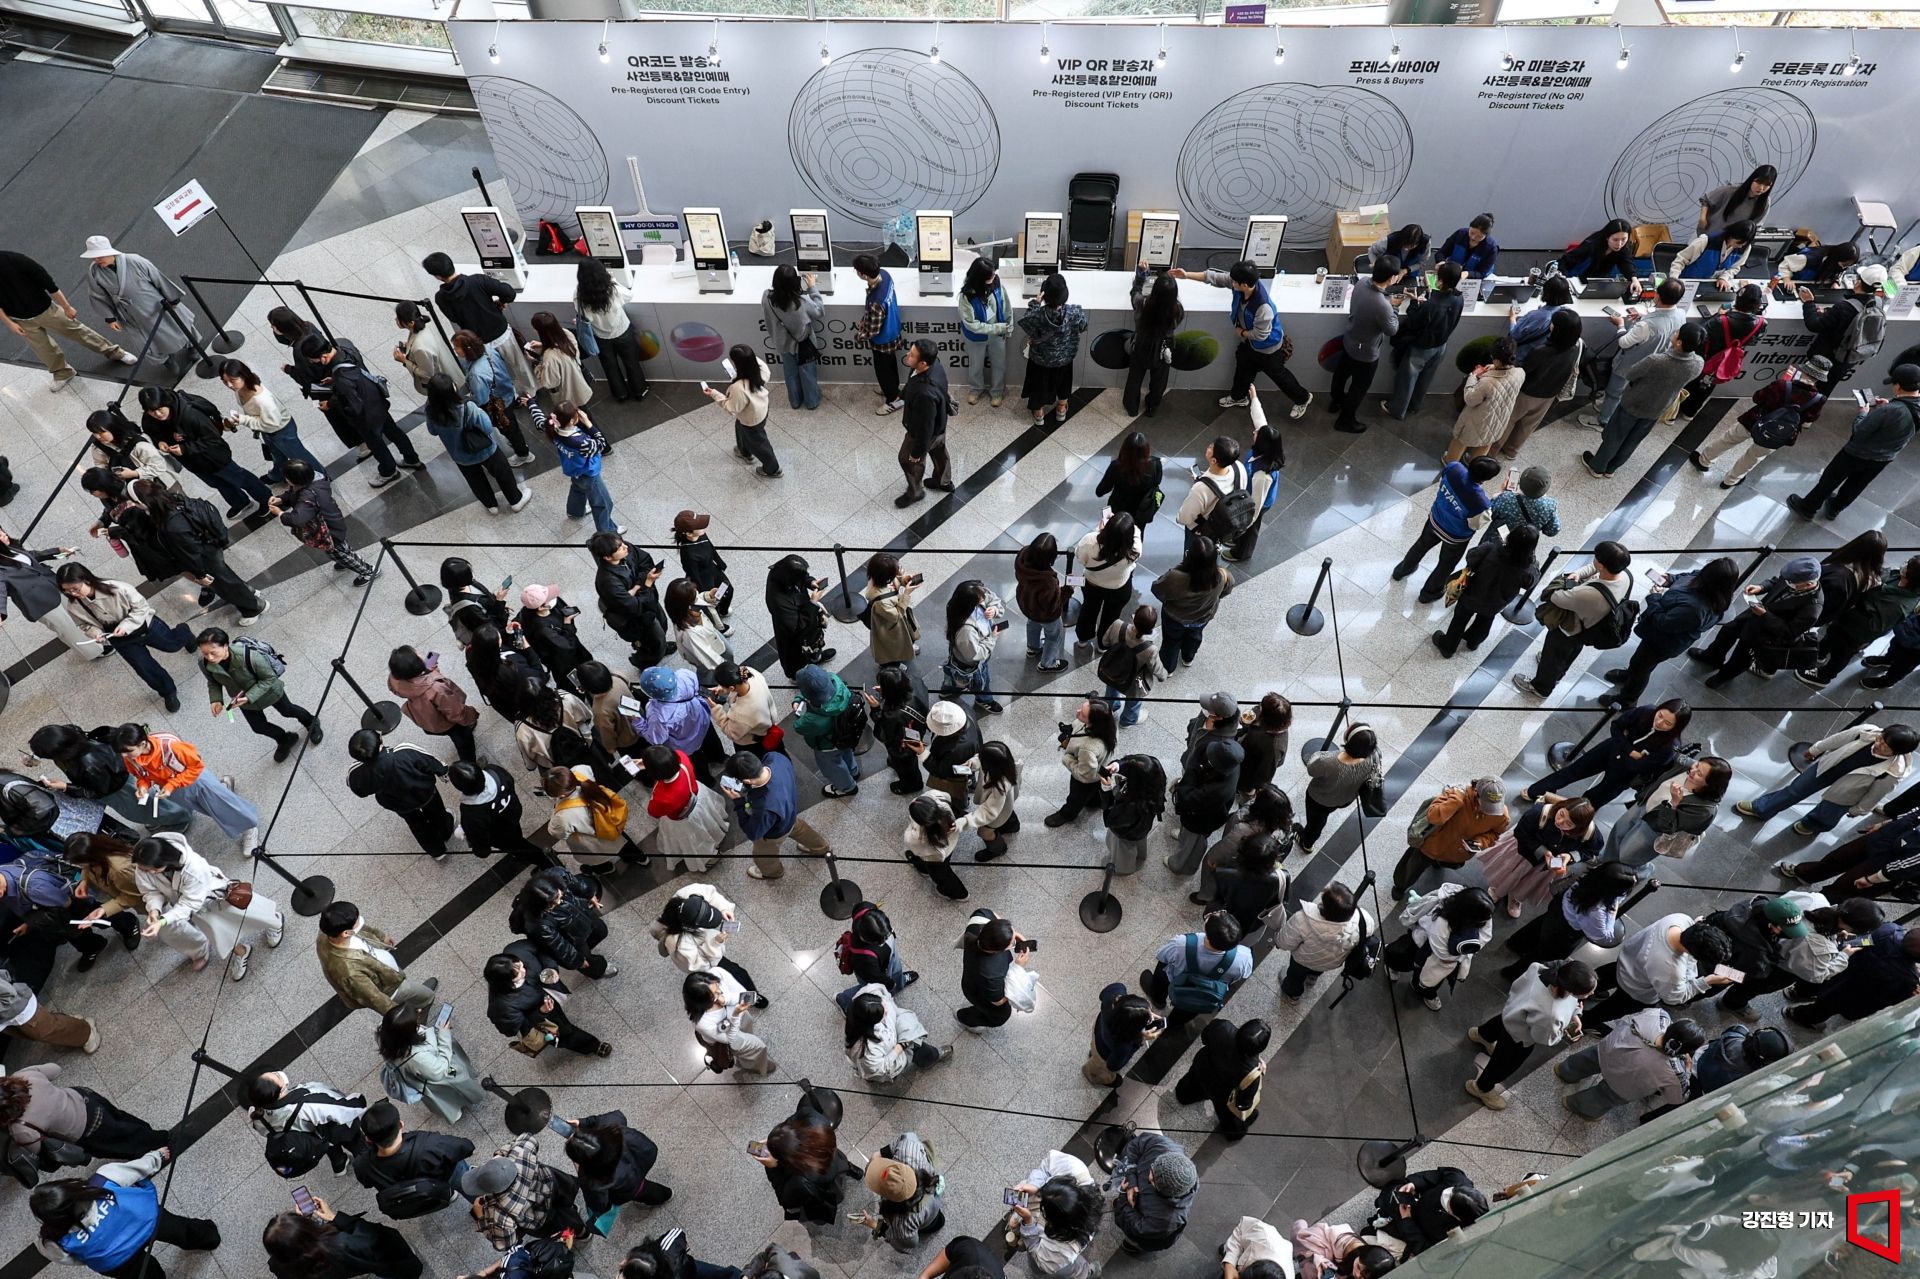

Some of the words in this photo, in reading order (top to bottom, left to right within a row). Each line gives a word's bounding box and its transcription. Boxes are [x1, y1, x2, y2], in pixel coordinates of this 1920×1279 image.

[627, 55, 677, 68] QR코드
[1057, 59, 1082, 71] VIP
[1086, 59, 1108, 72] QR
[1112, 59, 1154, 72] 발송자
[1349, 60, 1441, 73] 프레스/바이어
[1527, 60, 1586, 73] 미발송자
[1769, 62, 1829, 75] 무료등록
[1829, 63, 1878, 76] 대자
[626, 71, 730, 82] 사전등록&할인예매
[1051, 74, 1158, 86] 사전등록&할인예매
[1355, 77, 1382, 85] Press
[1383, 77, 1391, 85] &
[1392, 77, 1424, 86] Buyers
[1482, 75, 1592, 88] 사전등록&할인예매
[1783, 79, 1809, 87] Entry
[1810, 79, 1868, 88] Registration
[611, 86, 677, 95] Pre-Registered
[679, 86, 696, 95] (QR
[698, 86, 721, 95] Code
[723, 87, 750, 95] Entry)
[1032, 89, 1100, 99] Pre-Registered
[1102, 90, 1121, 99] (VIP
[1123, 91, 1146, 100] Entry
[1149, 91, 1173, 100] (QR))
[1478, 91, 1547, 100] Pre-Registered
[1548, 92, 1565, 100] (No
[1566, 92, 1584, 101] QR)
[646, 96, 686, 104] Discount
[687, 96, 720, 104] Tickets
[1064, 100, 1104, 108] Discount
[1106, 100, 1139, 109] Tickets
[1488, 101, 1530, 109] Discount
[1532, 102, 1565, 110] Tickets
[1439, 484, 1462, 512] STAFF
